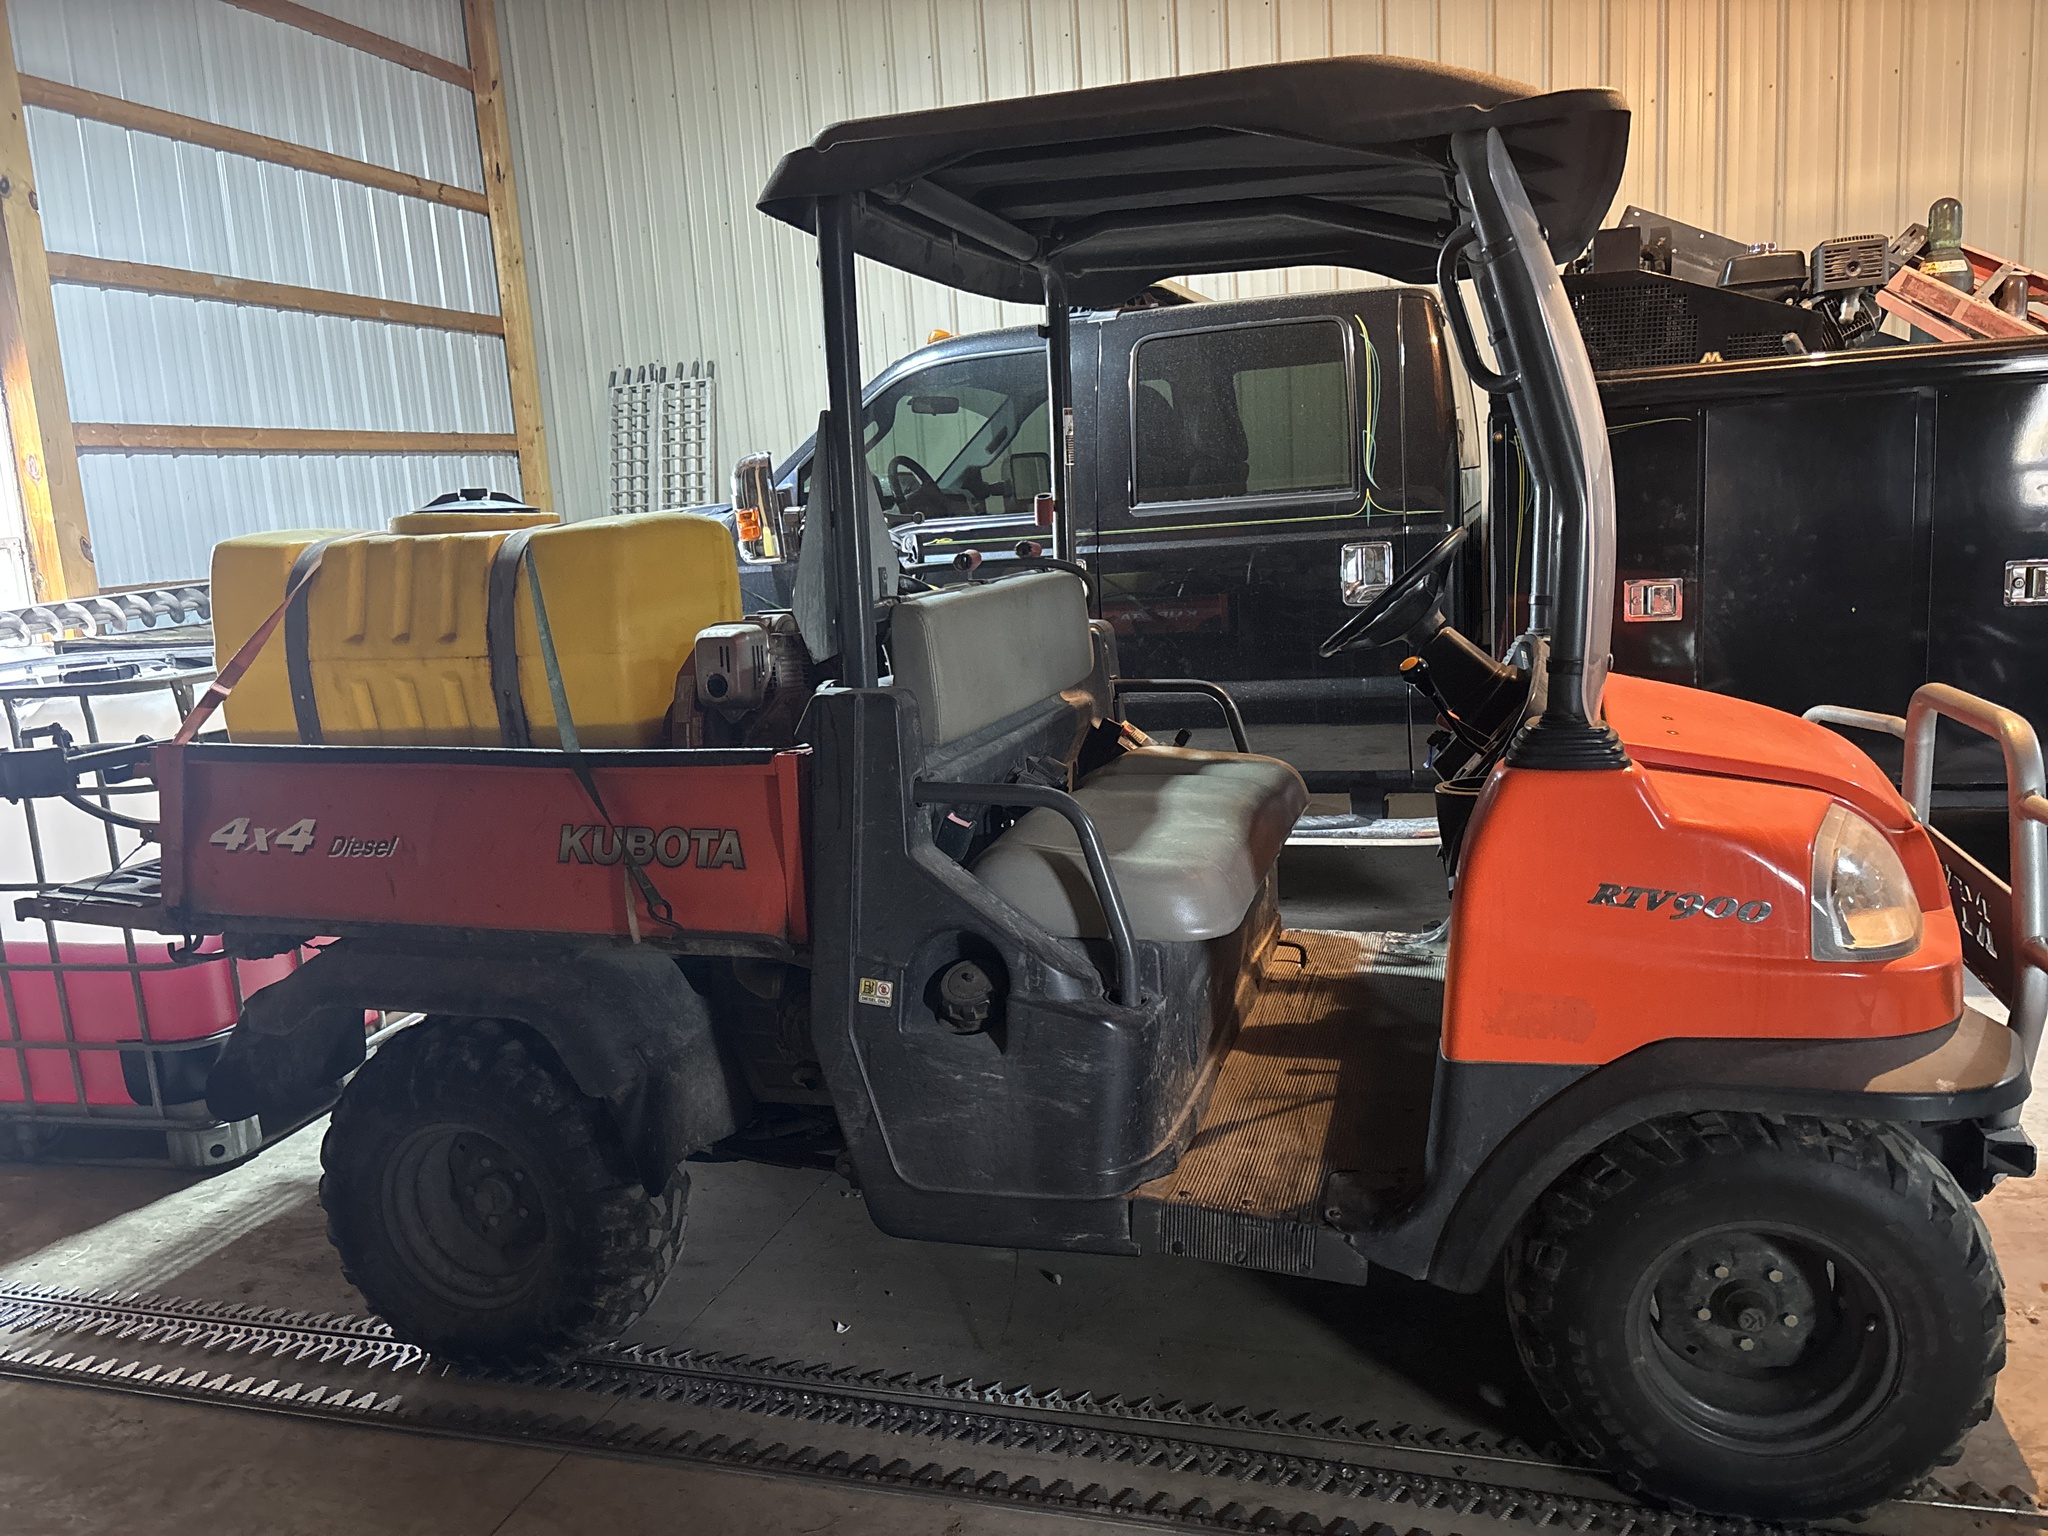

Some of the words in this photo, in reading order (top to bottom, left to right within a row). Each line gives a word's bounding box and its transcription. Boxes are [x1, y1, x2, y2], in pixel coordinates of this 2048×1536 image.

[209, 817, 317, 853] 4x4
[328, 835, 400, 859] Diesel
[558, 823, 747, 870] KUBOTA
[1587, 882, 1773, 924] RTV900
